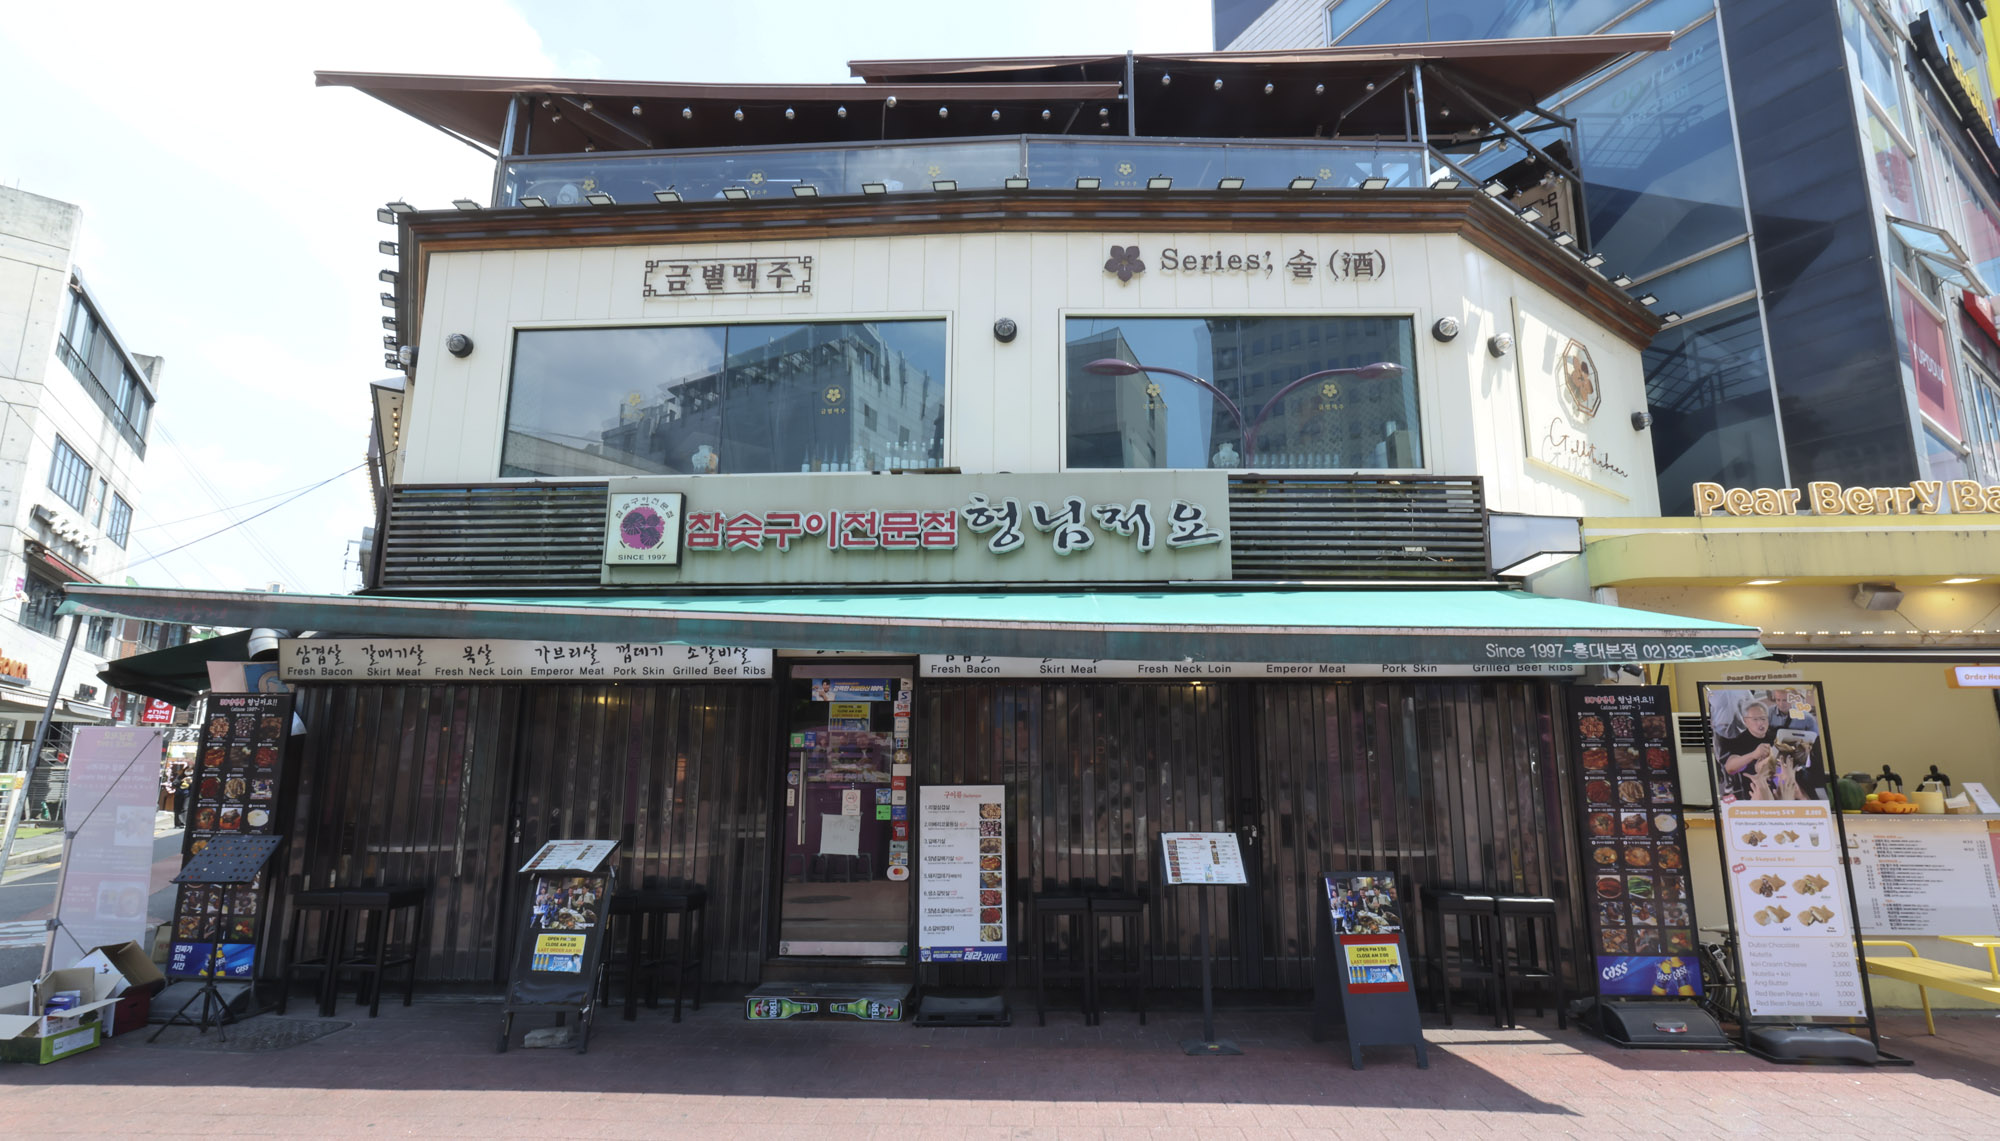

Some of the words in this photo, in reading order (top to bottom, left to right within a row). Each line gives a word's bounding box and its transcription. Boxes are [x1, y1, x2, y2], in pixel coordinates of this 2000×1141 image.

[665, 262, 793, 292] 금별맥주
[1693, 481, 1801, 517] Pear
[1808, 479, 1943, 516] Berry
[686, 509, 958, 551] 참숯구이전문점
[296, 644, 344, 665] 삼겹살
[361, 643, 427, 666] 갈매기살
[463, 644, 495, 666] 목살
[535, 643, 600, 665] 가브리살
[616, 643, 664, 663] 껍데기
[688, 645, 752, 665] 소갈비살
[1486, 644, 1525, 658] Since
[287, 667, 315, 676] Fresh
[321, 667, 353, 676] Bacon
[367, 667, 391, 676] Skirt
[396, 667, 421, 676] Meat
[435, 667, 463, 676] Fresh
[469, 667, 495, 676] Neck
[501, 667, 523, 676] Loin
[530, 667, 574, 677] Emperor
[579, 667, 604, 675] Meat
[614, 667, 636, 675] Pork
[642, 667, 665, 675] Skin
[673, 667, 708, 675] Grilled
[713, 667, 738, 675] Beef
[743, 667, 766, 675] Ribs
[931, 664, 961, 674] Fresh
[967, 664, 1000, 674] Bacon
[1040, 664, 1065, 674] Skirt
[1071, 664, 1097, 674] Meat
[1138, 664, 1168, 673] Fresh
[1174, 664, 1202, 673] Neck
[1208, 664, 1232, 673] Loin
[1266, 664, 1313, 674] Emperor
[1319, 664, 1346, 673] Meat
[1382, 664, 1407, 673] Pork
[1413, 664, 1438, 673] Skin
[1473, 664, 1514, 673] Grilled
[1964, 673, 1987, 681] Order
